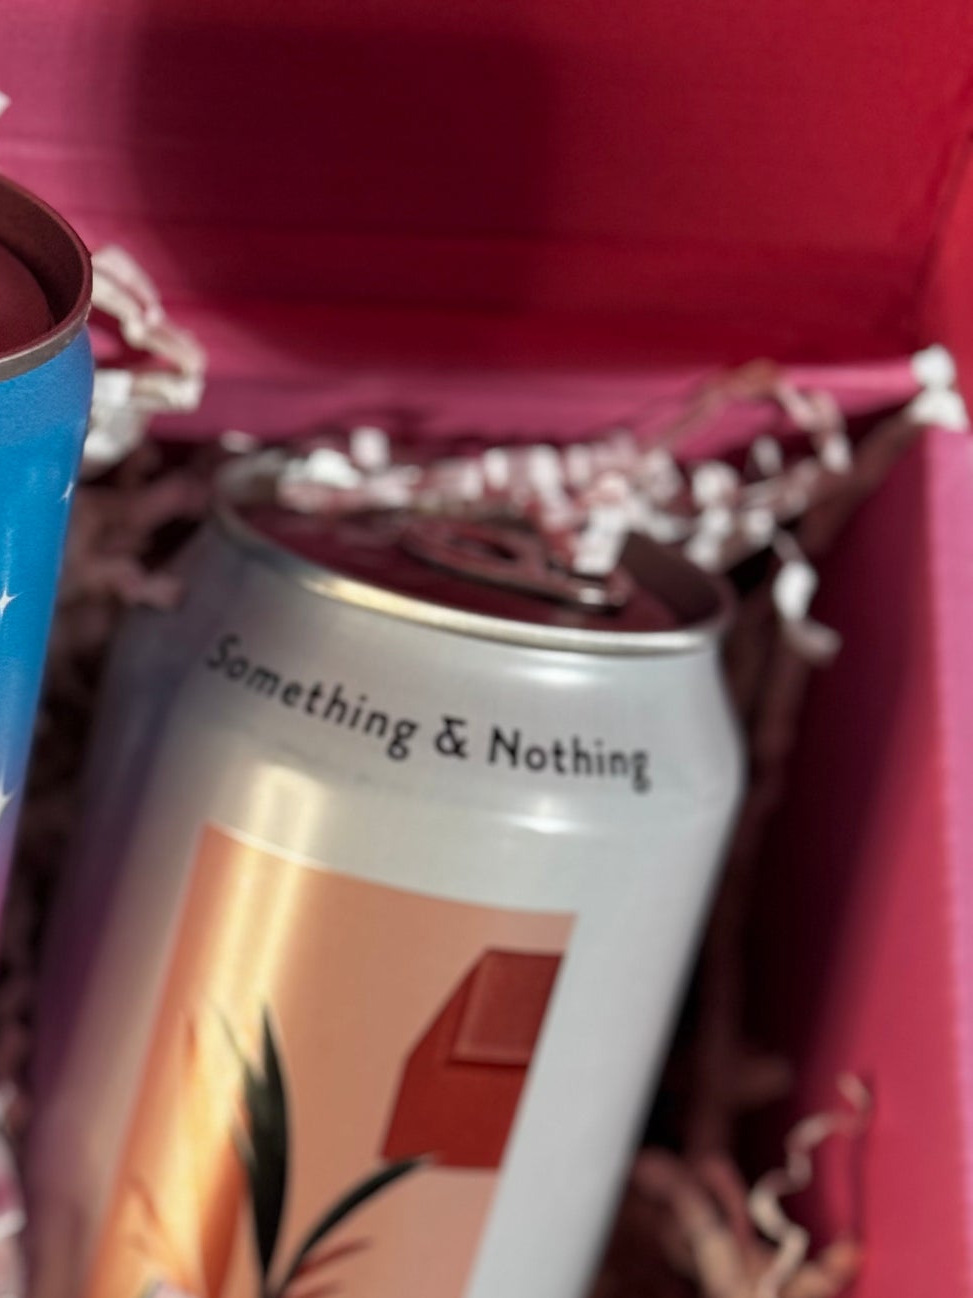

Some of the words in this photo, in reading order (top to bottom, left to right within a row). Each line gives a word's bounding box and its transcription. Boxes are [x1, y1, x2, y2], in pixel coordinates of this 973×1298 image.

[205, 634, 421, 762] Something
[434, 716, 469, 758] &
[488, 726, 650, 794] Nothing
